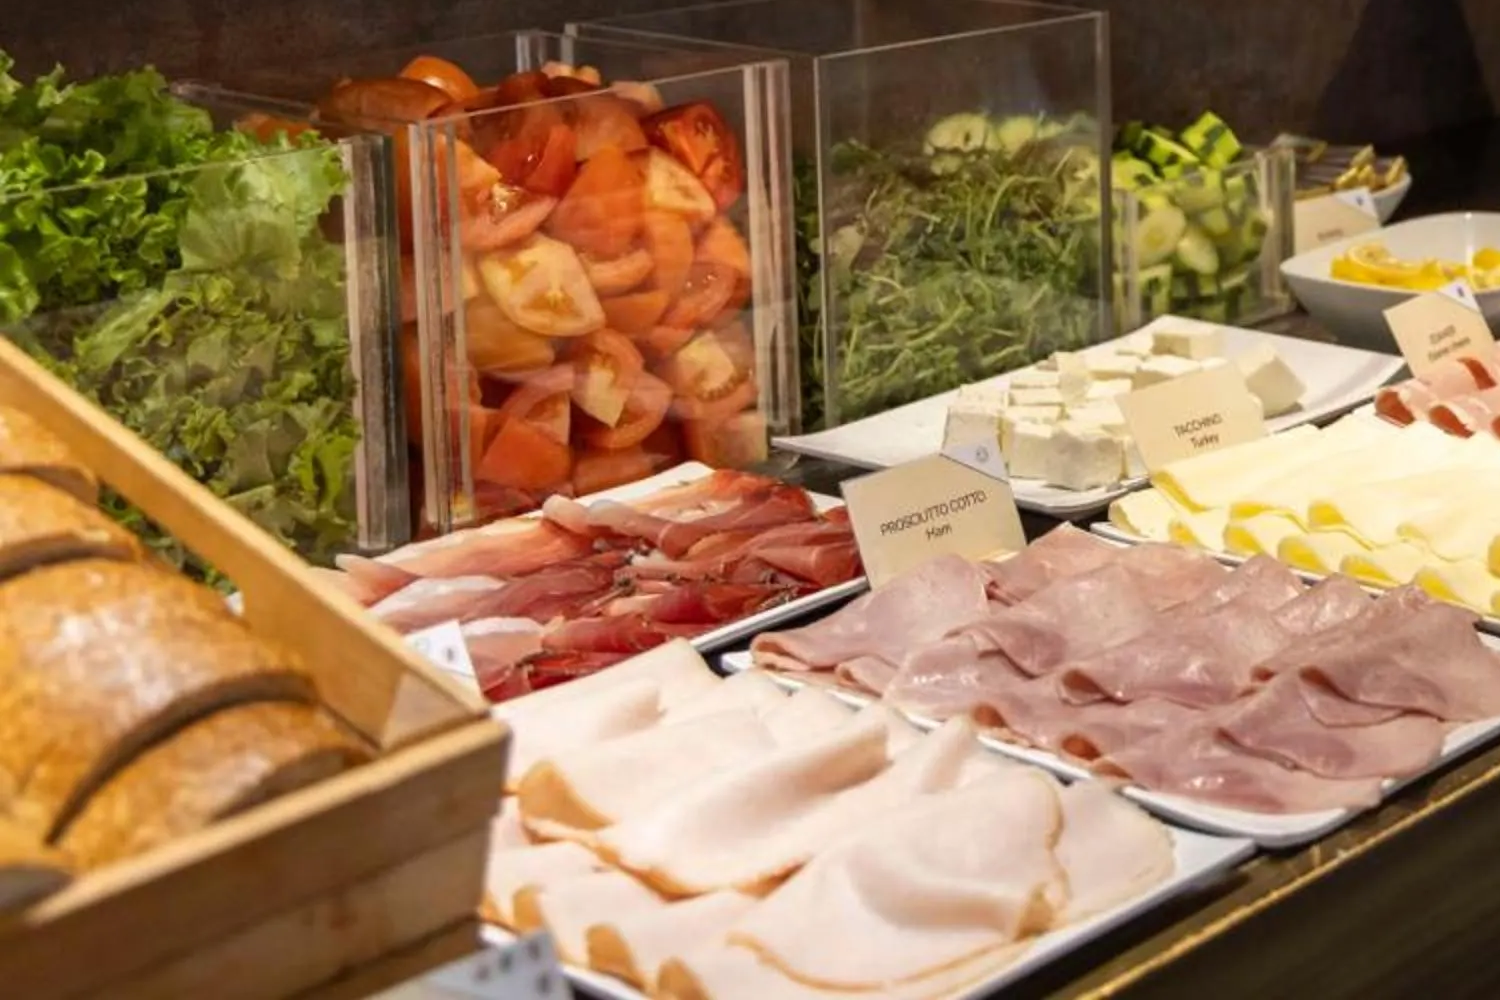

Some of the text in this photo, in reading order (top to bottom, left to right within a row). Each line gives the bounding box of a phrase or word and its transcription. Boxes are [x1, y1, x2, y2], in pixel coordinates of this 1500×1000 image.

[1173, 412, 1223, 437] TACCHINO
[1189, 433, 1220, 449] Turkey
[880, 489, 988, 536] PROSCIUTTO COTTO
[925, 523, 953, 540] Ham
